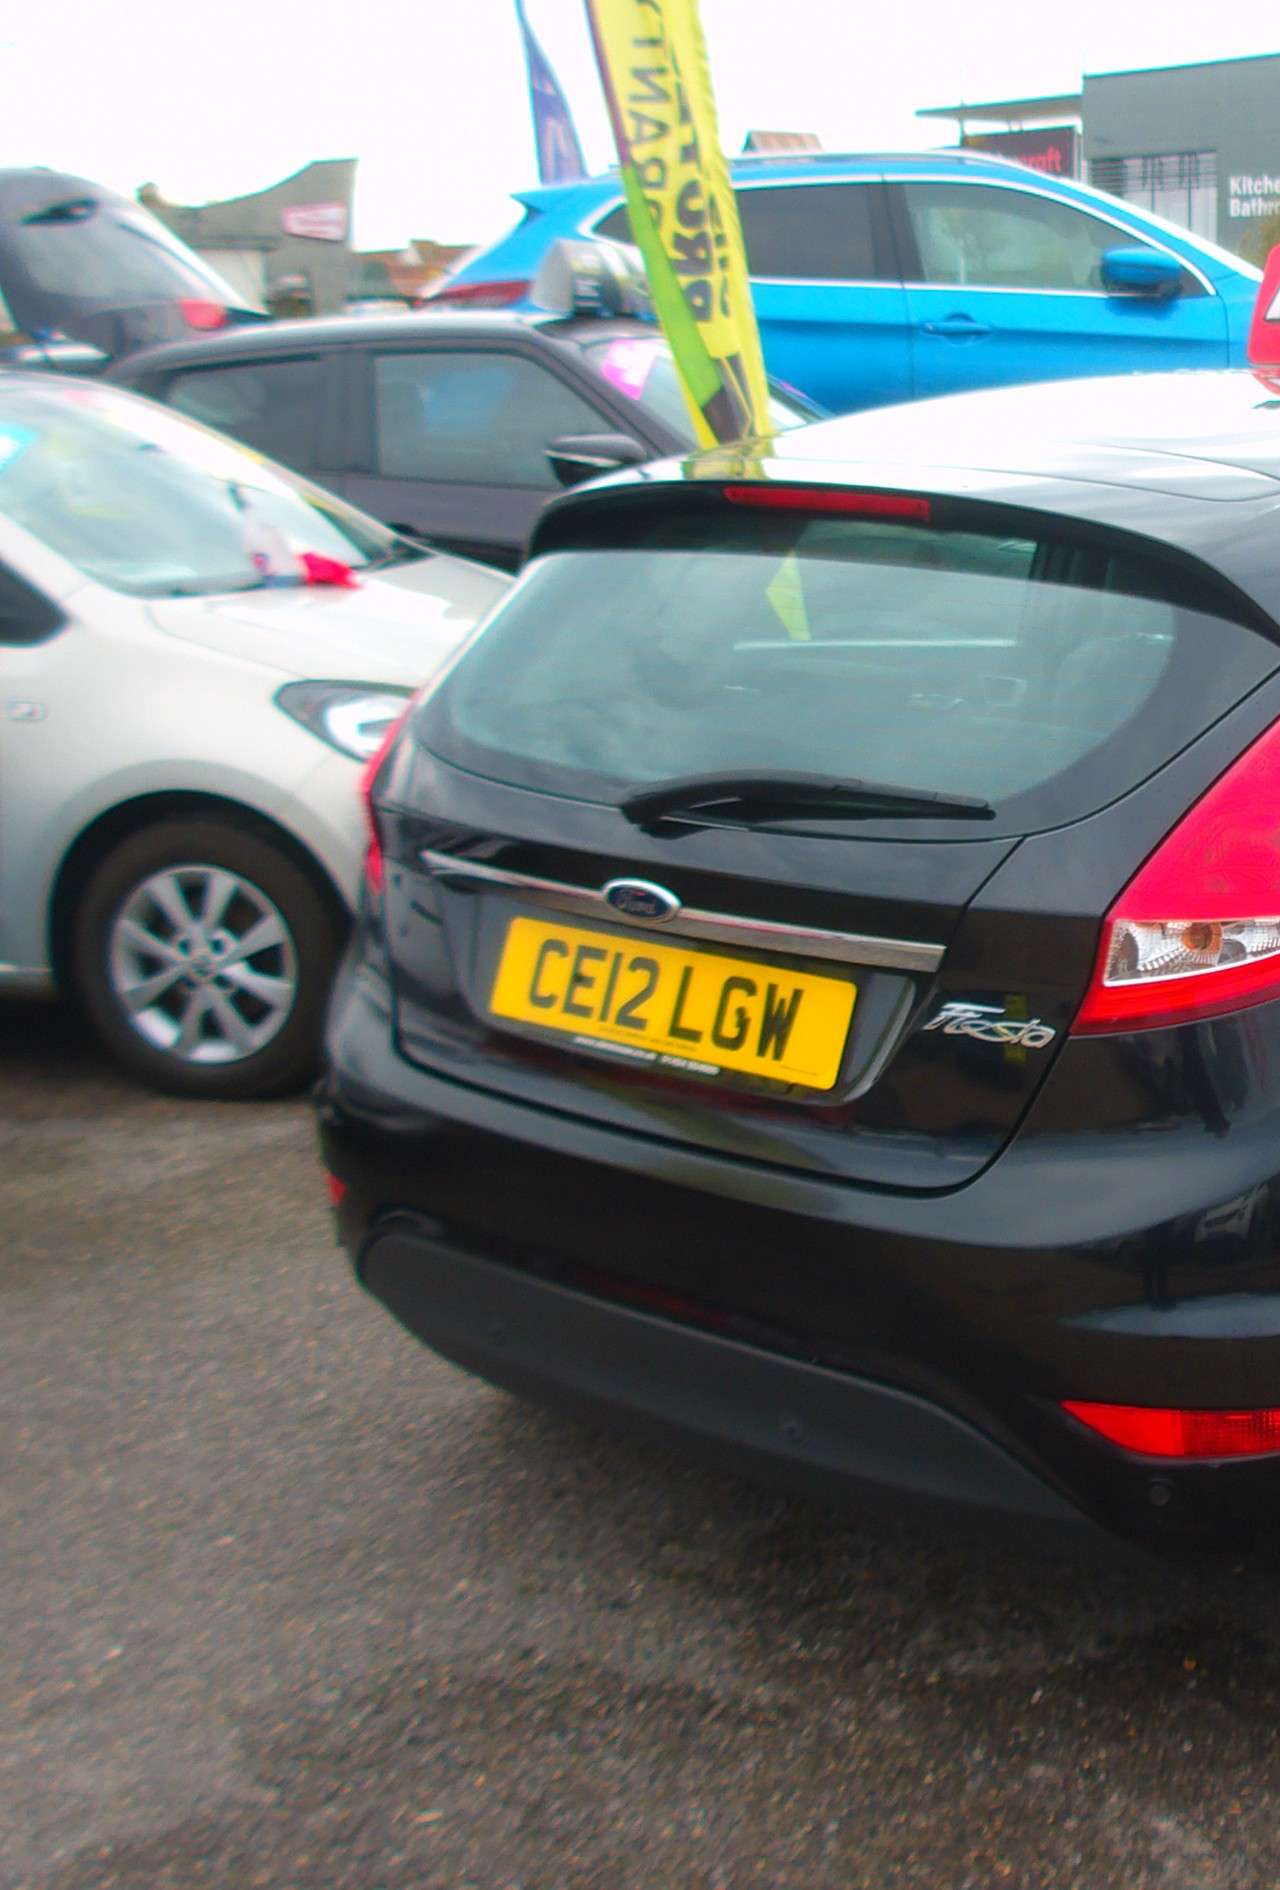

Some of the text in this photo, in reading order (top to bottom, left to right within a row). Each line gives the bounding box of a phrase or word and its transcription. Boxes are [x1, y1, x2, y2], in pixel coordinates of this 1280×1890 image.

[528, 938, 805, 1062] CE12 LGW
[922, 1002, 1057, 1048] Fiesta
